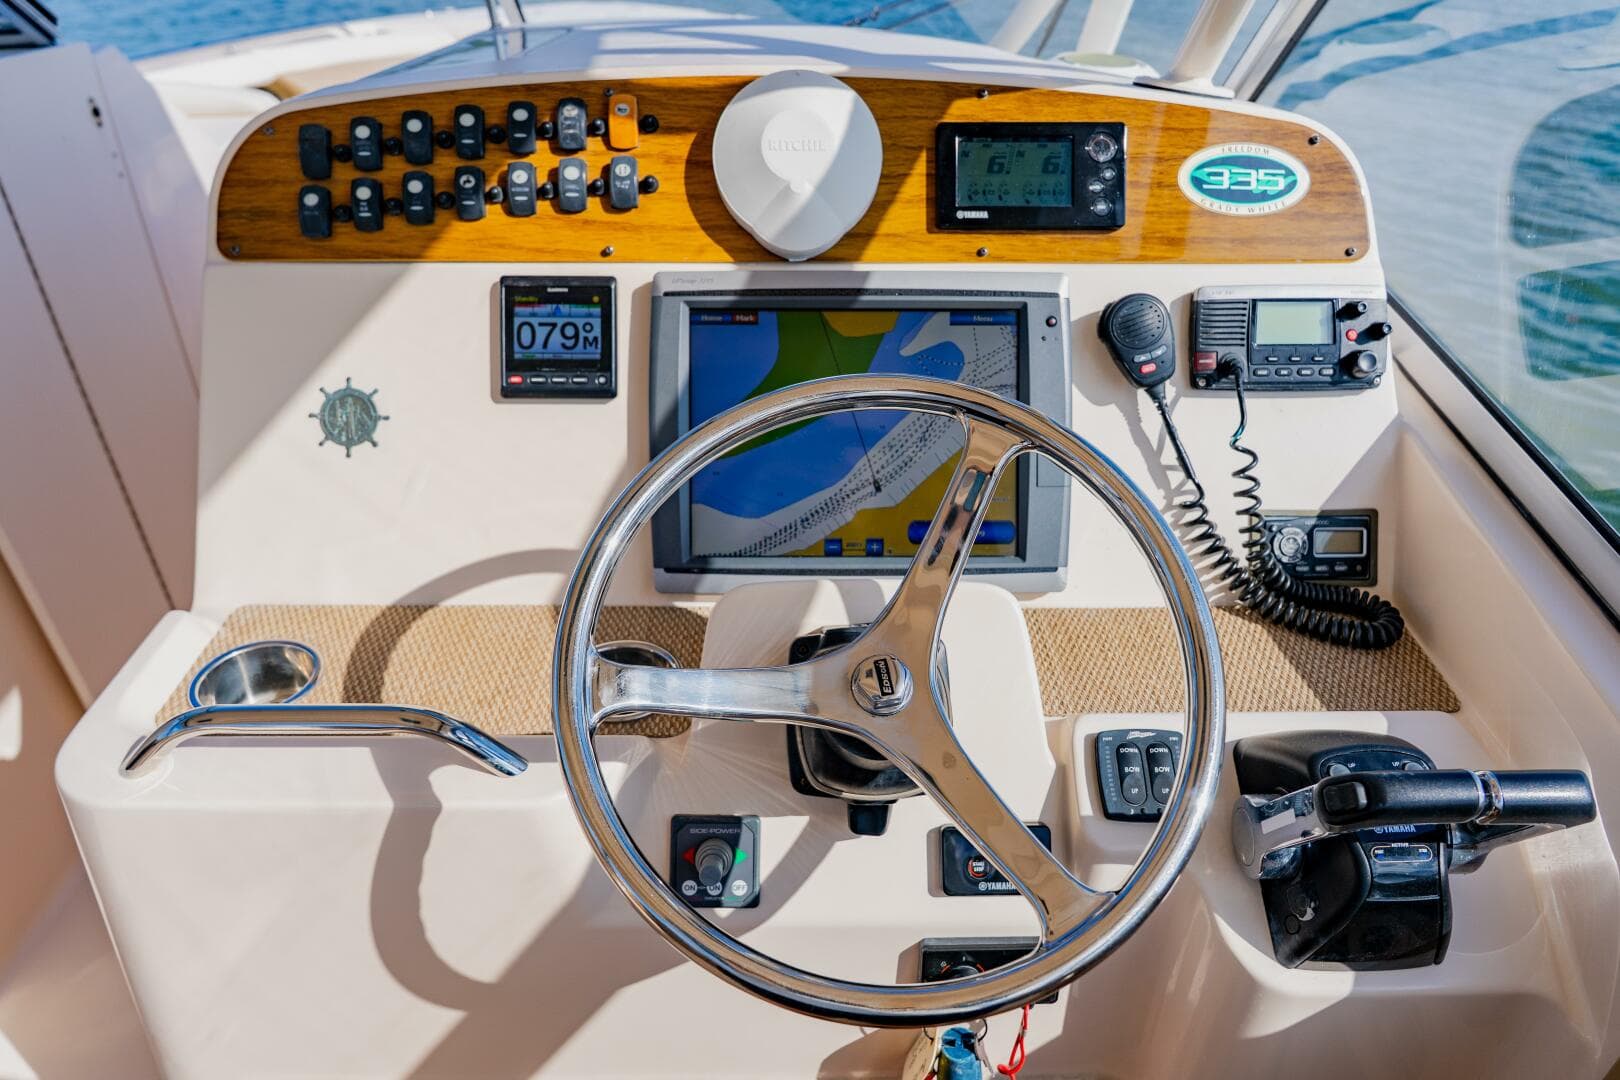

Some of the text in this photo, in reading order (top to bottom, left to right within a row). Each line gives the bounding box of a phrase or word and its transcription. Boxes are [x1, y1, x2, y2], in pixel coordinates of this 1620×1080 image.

[768, 139, 826, 152] RITCHIE
[1221, 145, 1270, 156] FREEDOM
[1202, 168, 1286, 190] 335
[877, 660, 893, 694] EDSON
[1384, 824, 1416, 832] YAMAHA
[683, 884, 696, 892] ON
